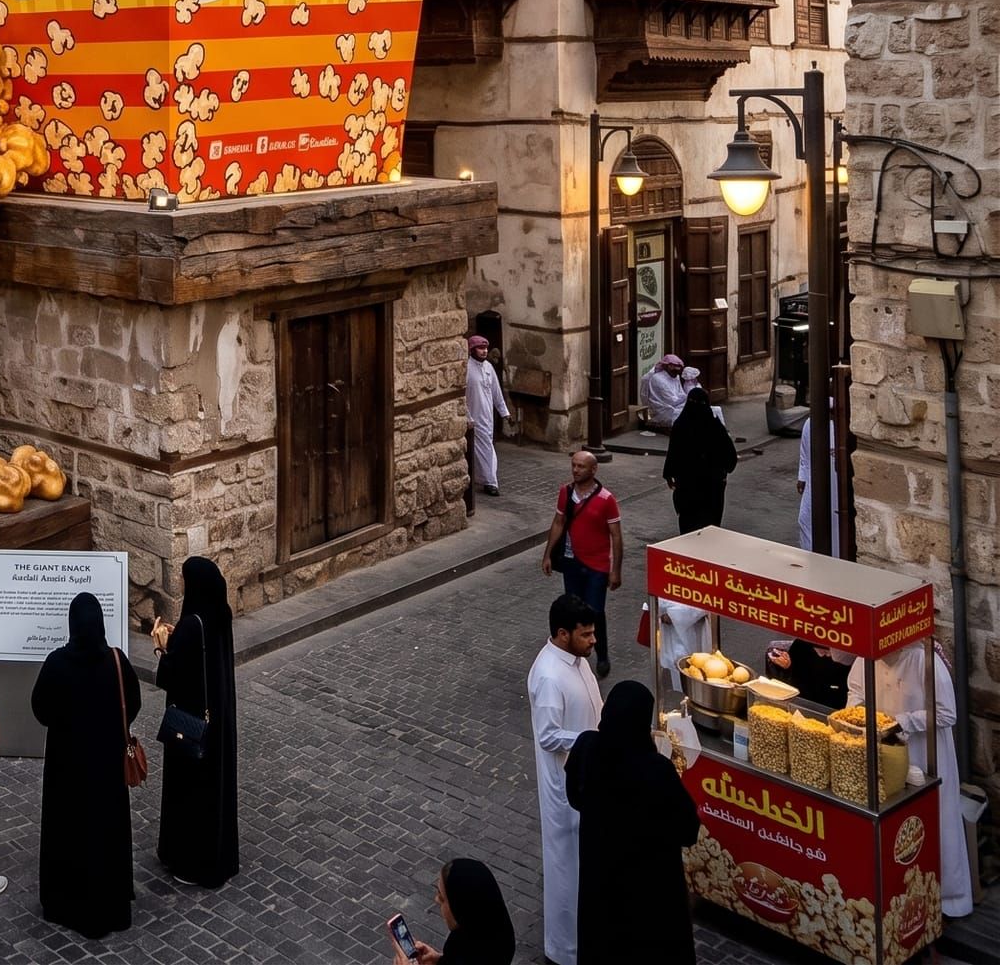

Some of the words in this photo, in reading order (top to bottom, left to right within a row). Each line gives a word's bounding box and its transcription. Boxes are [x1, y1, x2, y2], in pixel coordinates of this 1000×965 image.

[14, 563, 31, 572] THE
[32, 564, 59, 573] GIANT
[724, 574, 789, 606] الخفيفة
[663, 582, 724, 610] JEDDAH
[728, 600, 790, 629] STREET
[793, 619, 853, 647] FFOOD
